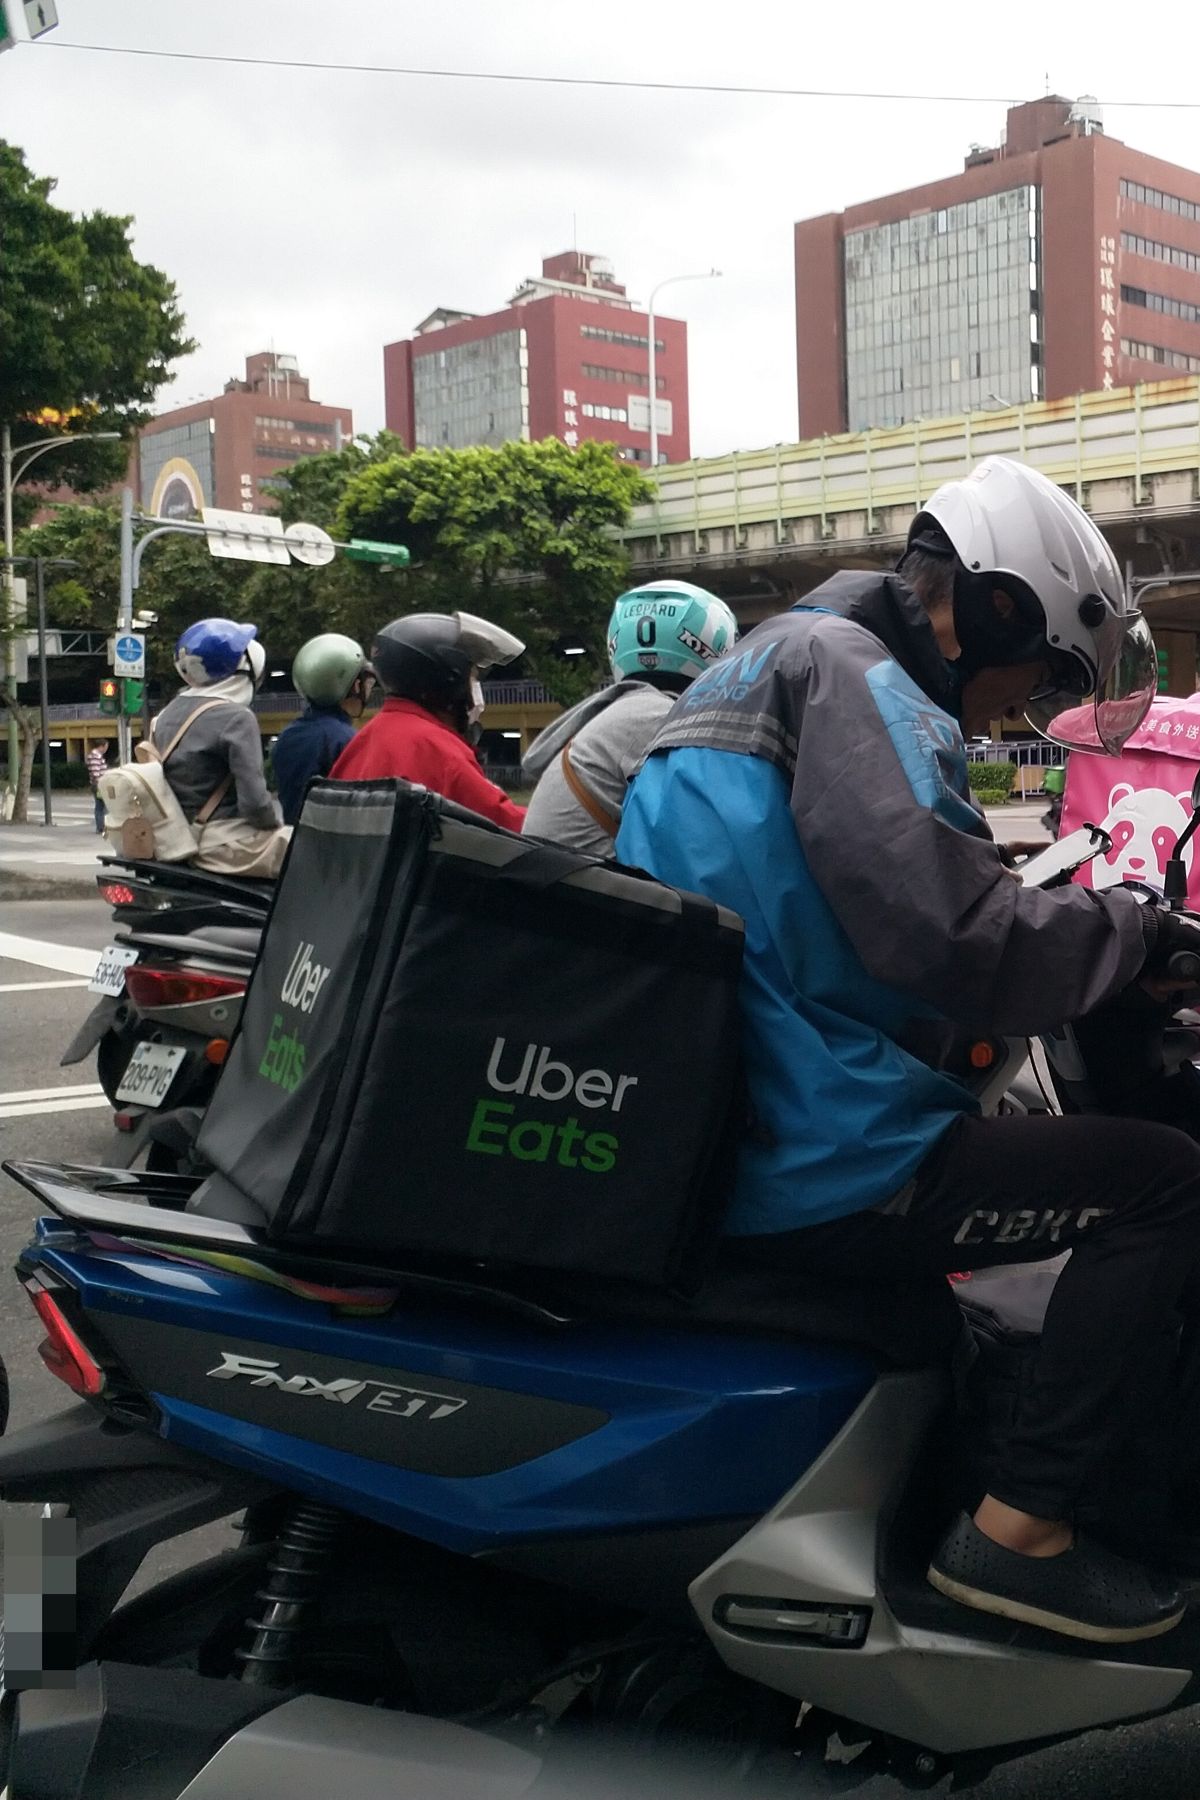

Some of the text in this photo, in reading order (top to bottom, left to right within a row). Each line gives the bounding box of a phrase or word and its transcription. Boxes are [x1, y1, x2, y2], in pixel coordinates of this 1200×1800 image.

[623, 603, 677, 618] LEOPARD
[281, 941, 331, 1015] Uber
[258, 1014, 309, 1095] Eats
[486, 1036, 638, 1113] Uber
[465, 1099, 620, 1174] Eats
